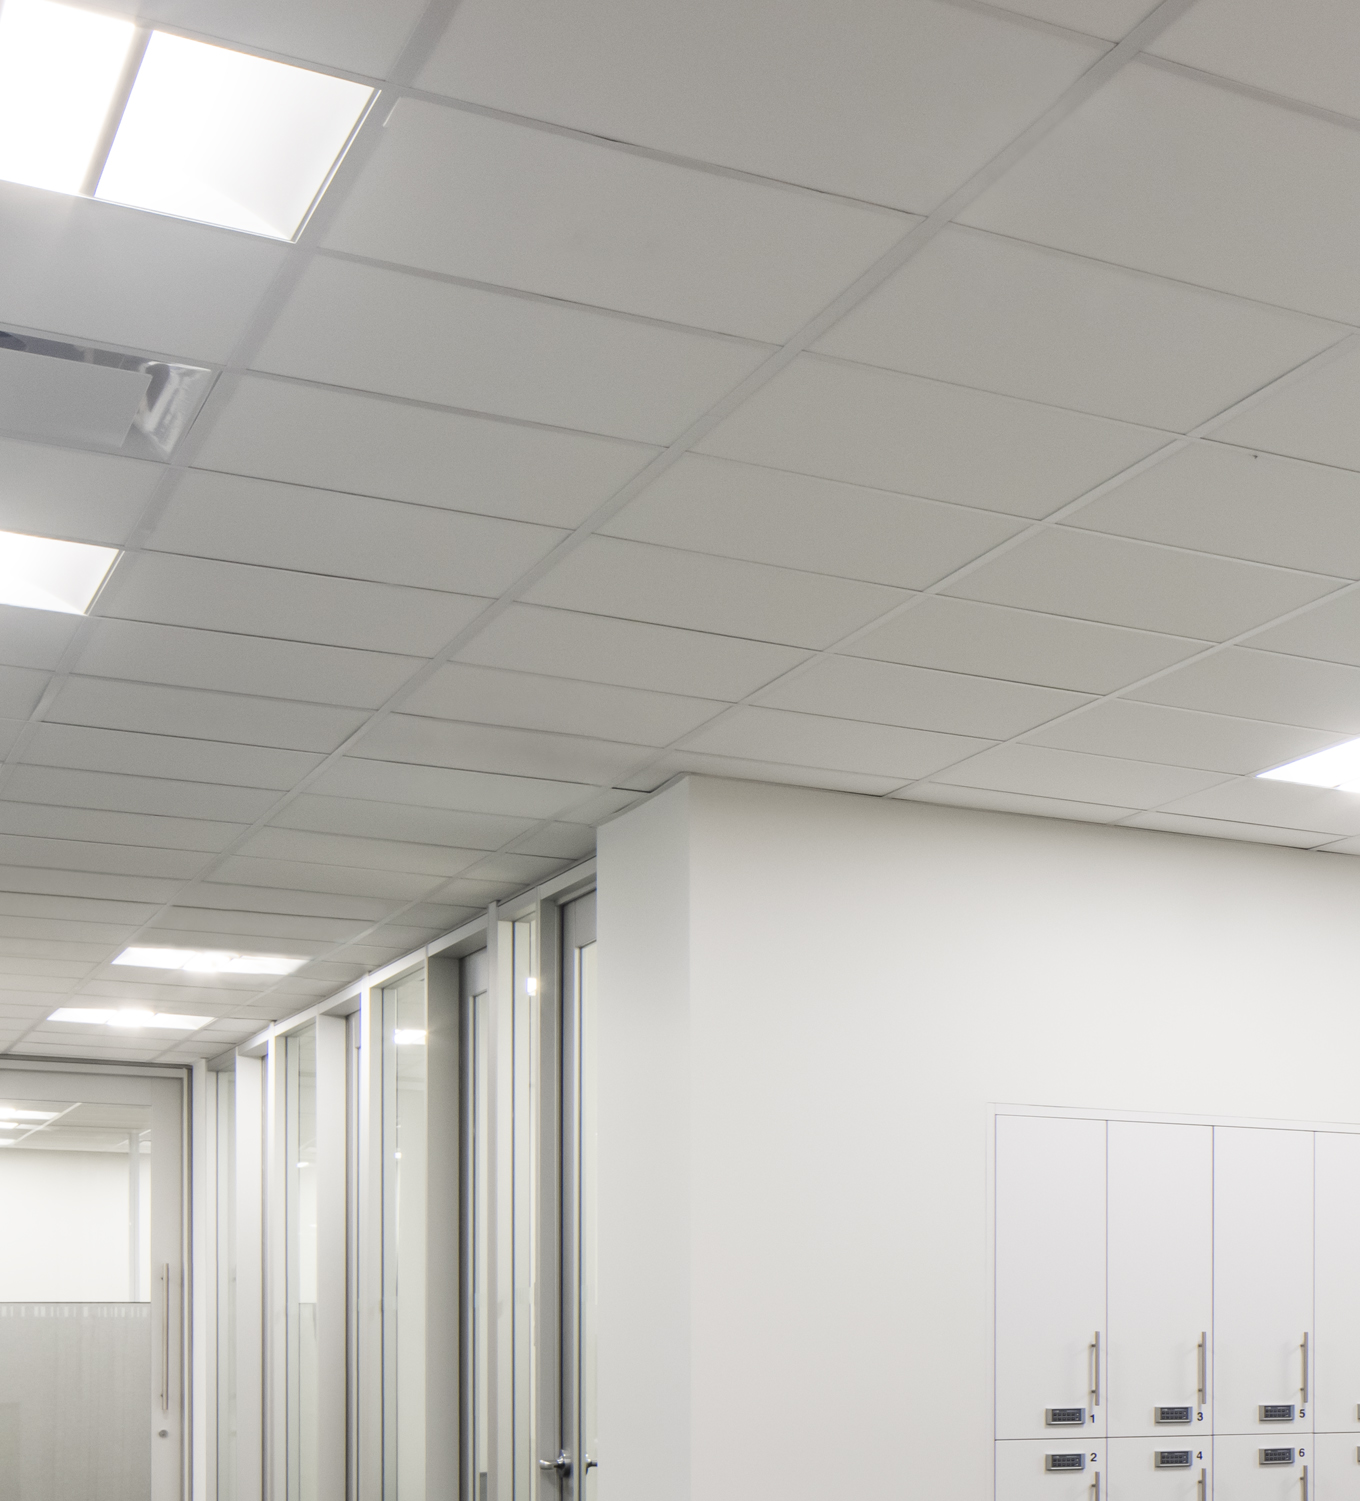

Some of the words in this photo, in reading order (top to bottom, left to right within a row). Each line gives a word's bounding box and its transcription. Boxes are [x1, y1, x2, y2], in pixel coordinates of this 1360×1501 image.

[1198, 1412, 1203, 1421] 3
[1300, 1409, 1305, 1418] 5
[1090, 1414, 1094, 1423] 1
[1091, 1453, 1097, 1461] 2
[1197, 1452, 1203, 1460] 4
[1299, 1448, 1305, 1457] 6
